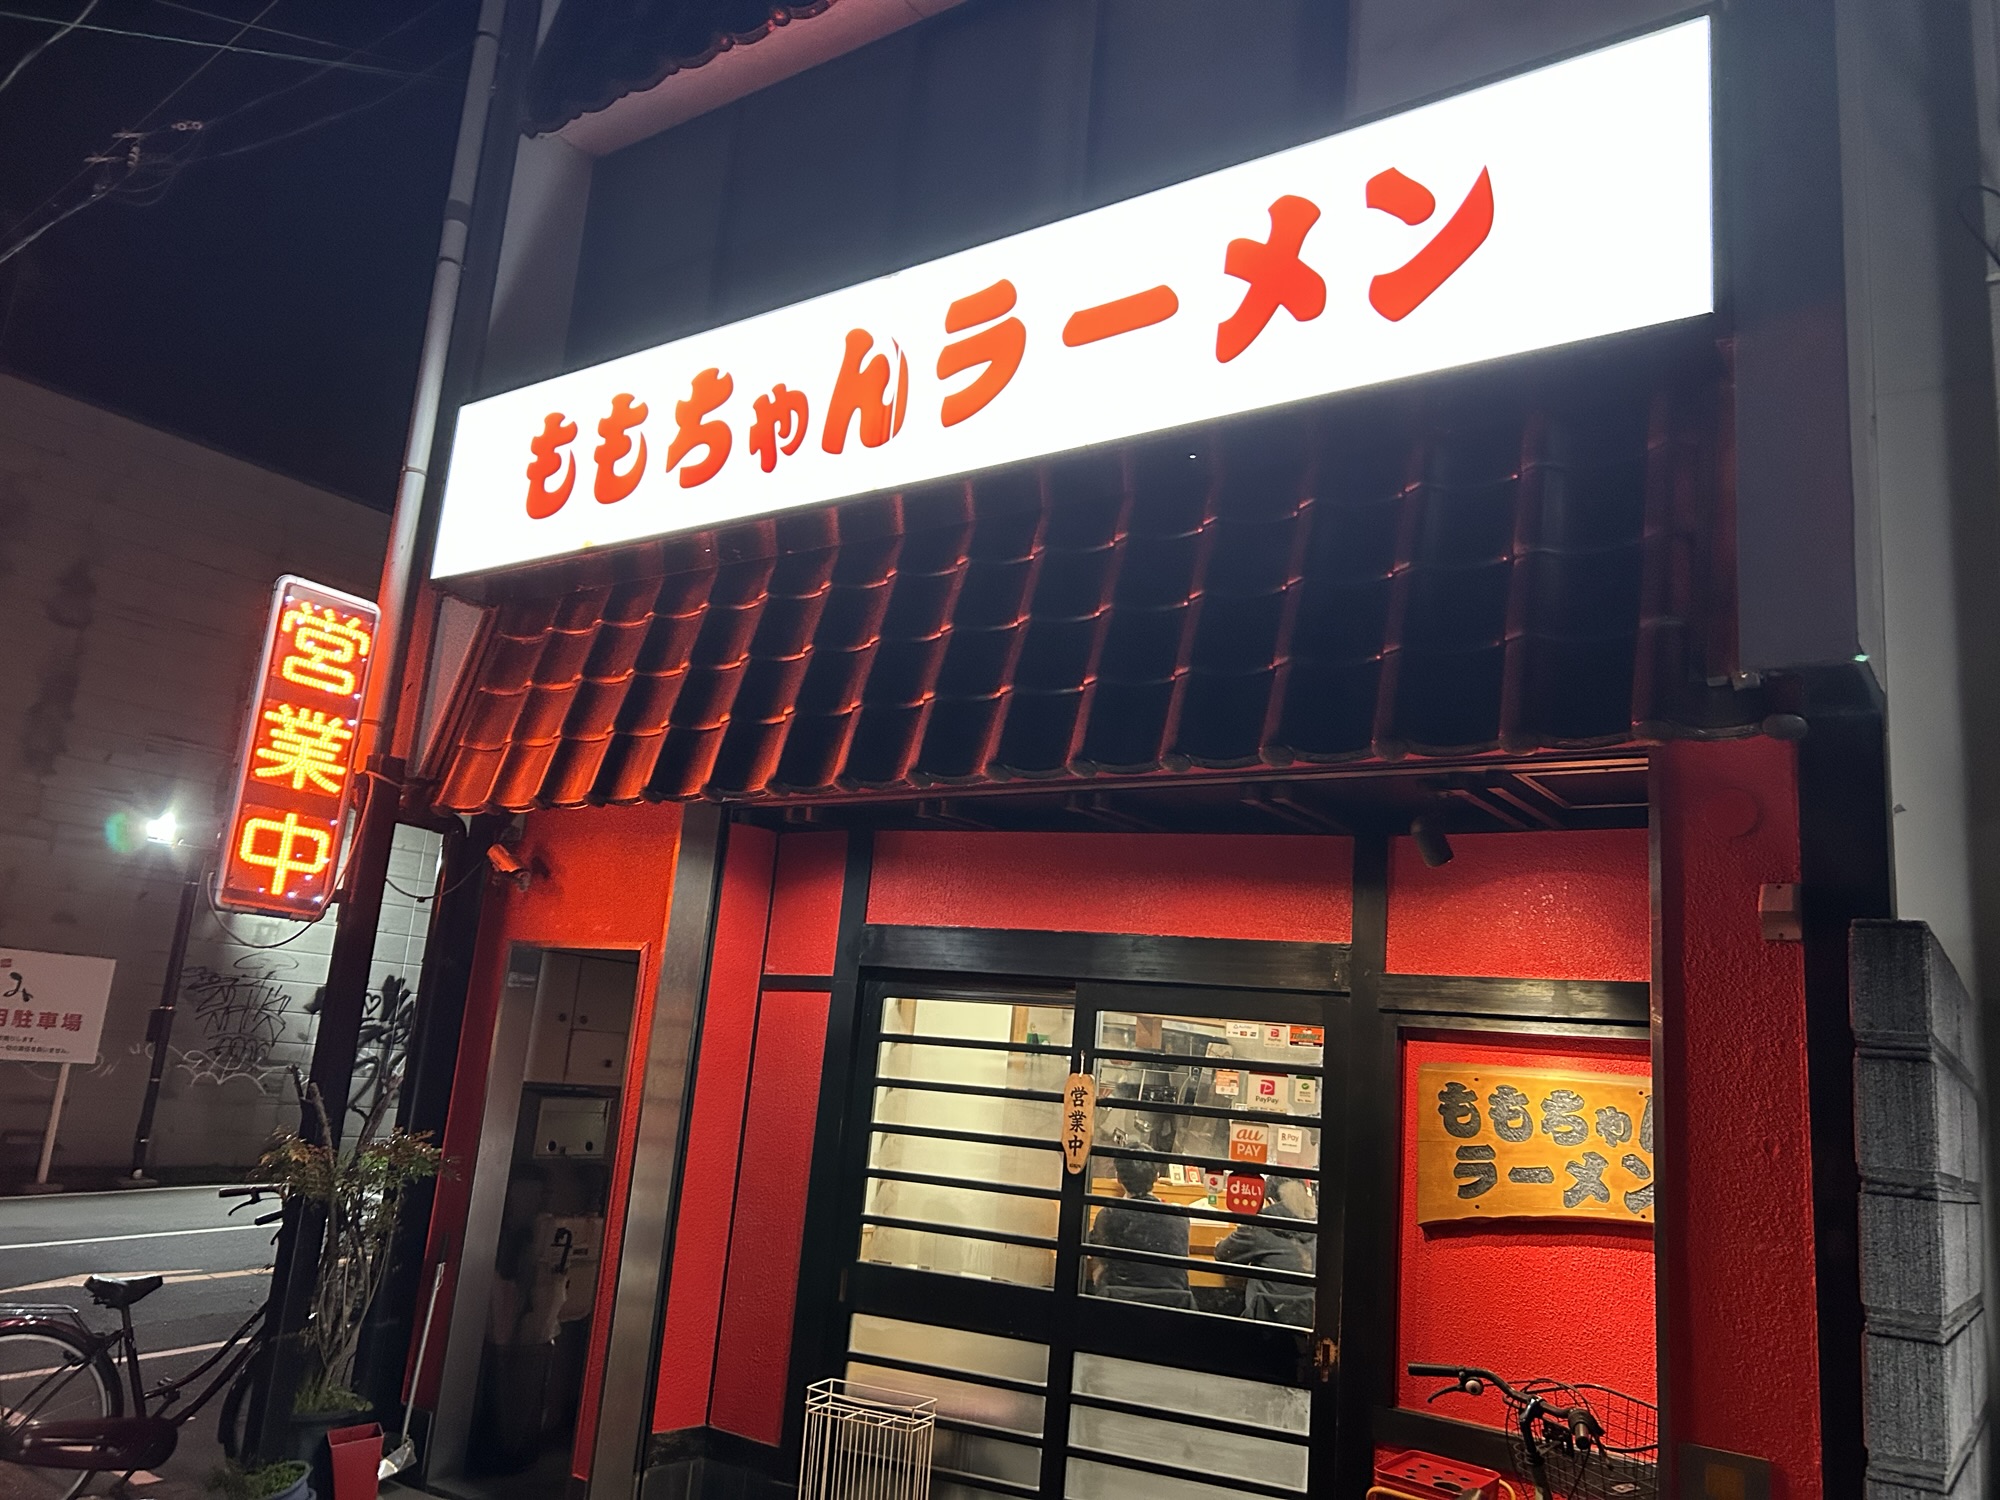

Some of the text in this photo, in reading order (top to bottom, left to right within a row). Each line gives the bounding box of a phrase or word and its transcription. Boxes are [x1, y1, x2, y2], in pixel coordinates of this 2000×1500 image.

[525, 165, 1494, 519] ももちゃんラーメン
[240, 601, 371, 896] 営業中
[1255, 1095, 1279, 1104] PayPay
[1068, 1086, 1089, 1157] 営業中
[1236, 1128, 1264, 1141] au
[1237, 1142, 1261, 1157] PAY
[1229, 1180, 1262, 1196] d払い
